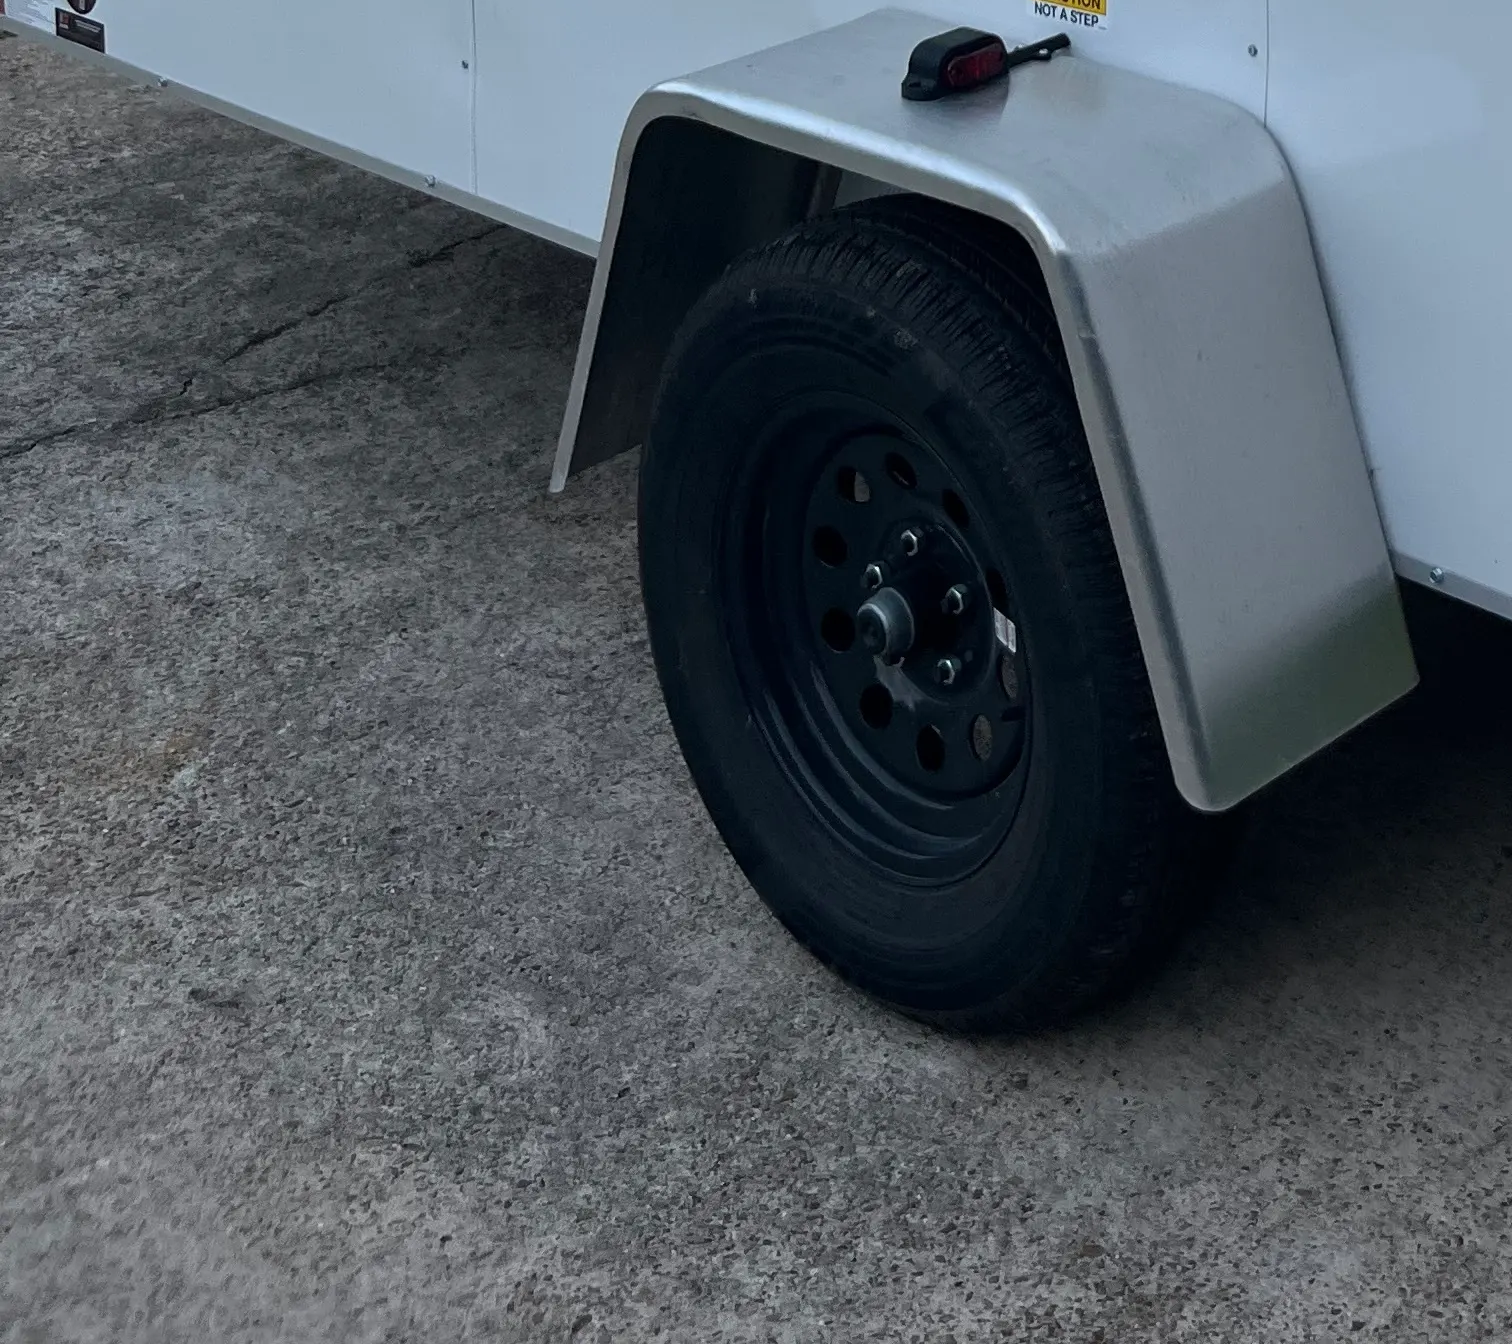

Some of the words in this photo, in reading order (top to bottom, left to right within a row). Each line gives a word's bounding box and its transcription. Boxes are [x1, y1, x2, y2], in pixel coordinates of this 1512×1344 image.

[1034, 1, 1057, 18] NOT
[1059, 8, 1068, 21] A
[1070, 10, 1099, 27] STEP
